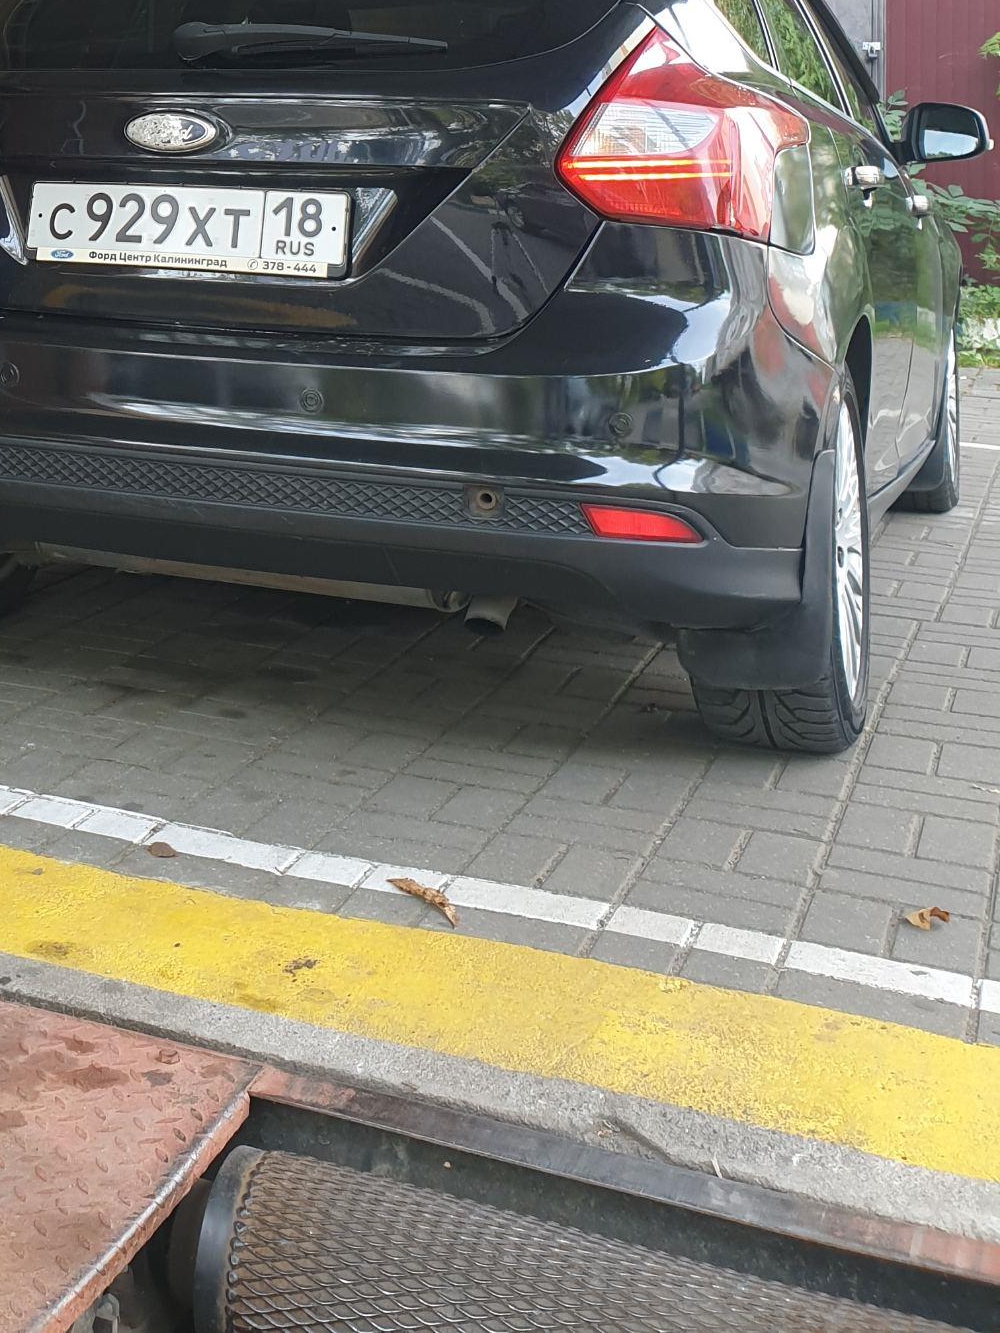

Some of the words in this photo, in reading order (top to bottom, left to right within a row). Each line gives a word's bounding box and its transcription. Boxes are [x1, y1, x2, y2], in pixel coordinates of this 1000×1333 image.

[271, 196, 323, 238] 18
[274, 240, 315, 256] RUS
[88, 250, 117, 262] Форд
[119, 251, 152, 264] Центр
[152, 254, 228, 268] Калининград
